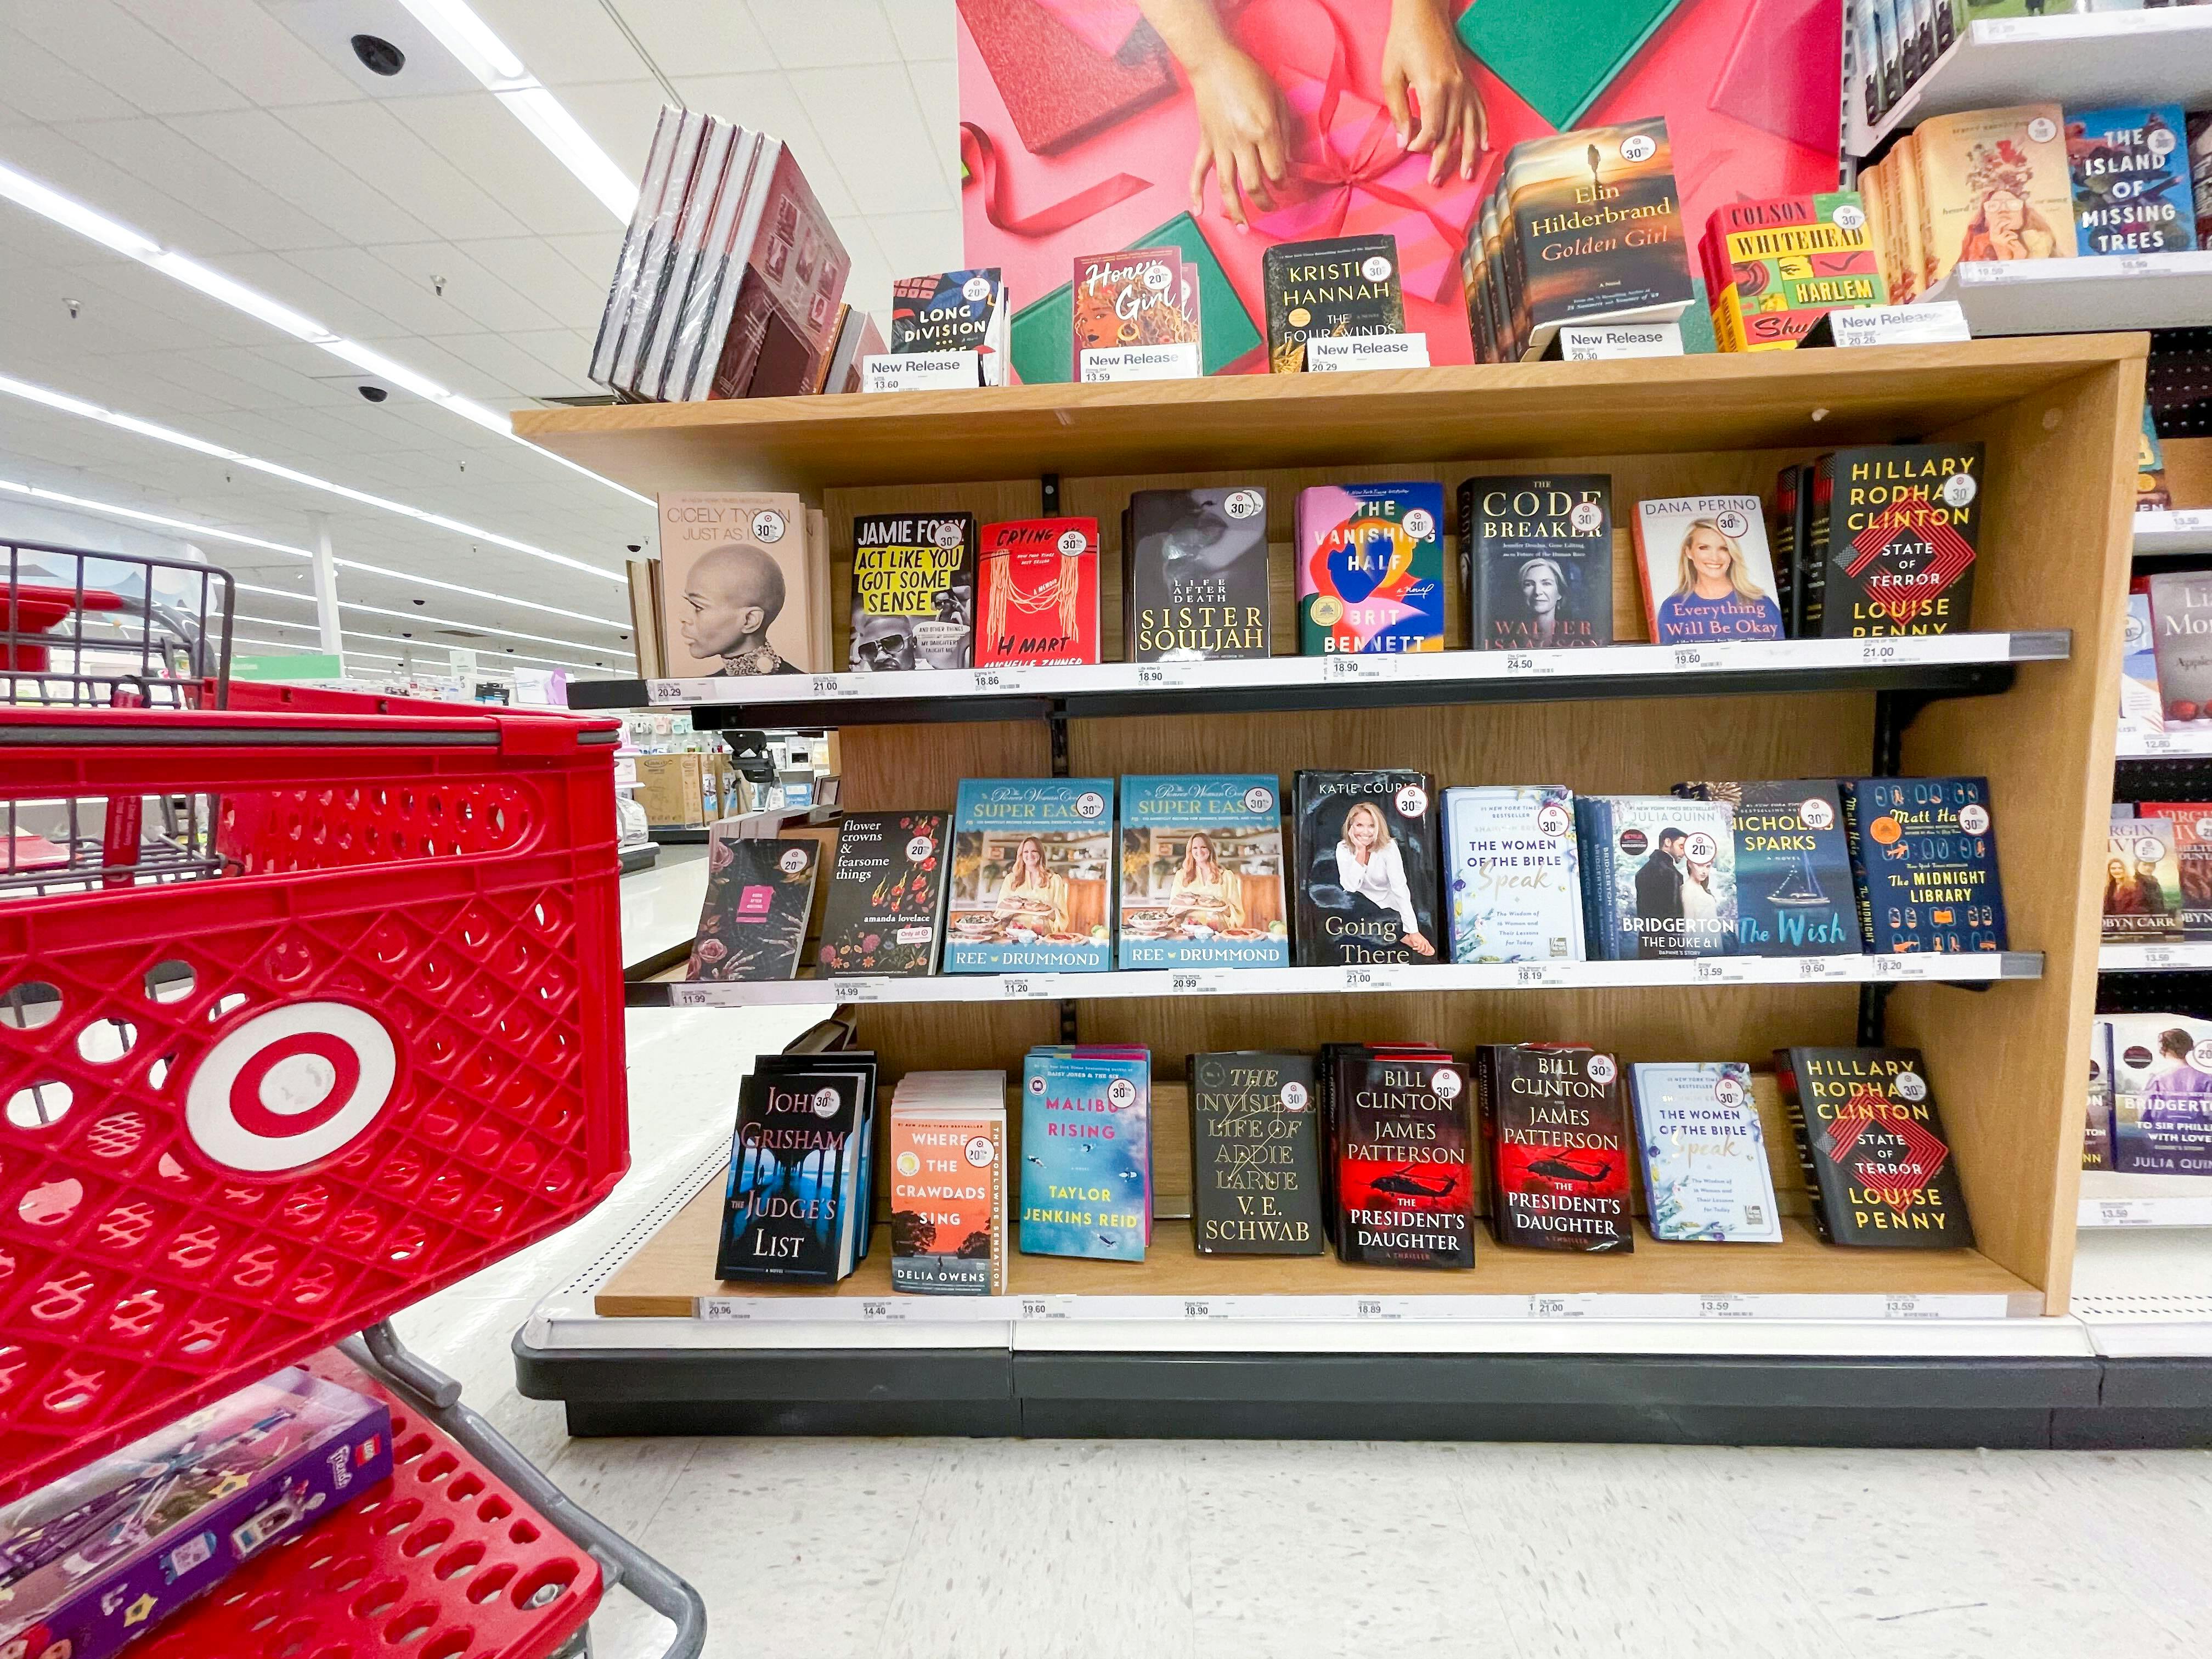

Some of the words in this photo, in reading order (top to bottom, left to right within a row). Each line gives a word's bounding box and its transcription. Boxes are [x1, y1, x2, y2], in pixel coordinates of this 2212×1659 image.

[2104, 128, 2144, 145] THE
[2085, 154, 2165, 176] ISLAND
[1576, 185, 1620, 204] Elin
[2112, 180, 2143, 199] OF
[1531, 197, 1671, 238] Hilderbrand
[1732, 201, 1807, 226] COLSON
[2082, 204, 2176, 228] MISSING
[1541, 236, 1617, 262] Golden
[1625, 225, 1668, 247] Girl
[1737, 228, 1864, 256] WHITEHEAD
[2098, 232, 2164, 252] TREES
[1283, 283, 1390, 306] HANNAH
[1796, 279, 1875, 303] HARLEM
[919, 304, 972, 324] LONG
[904, 320, 986, 343] DIVISION
[1571, 335, 1602, 345] New
[1607, 332, 1663, 343] Release
[871, 362, 902, 374] New
[906, 359, 961, 372] Release
[1312, 363, 1337, 371] 20.29
[1086, 373, 1110, 381] 13.59
[874, 380, 899, 388] 13.60
[1645, 501, 1692, 516] DANA
[1699, 498, 1757, 513] PERINO
[862, 571, 895, 591] GOT
[899, 571, 948, 590] SOME
[1039, 578, 1057, 592] MEMOIR
[1173, 586, 1226, 595] AFTER
[868, 591, 928, 613] SENSE
[1174, 595, 1226, 603] DEATH
[1673, 602, 1767, 620] Everything
[1141, 607, 1263, 630] SISTER
[1665, 622, 1706, 637] Will
[1709, 620, 1730, 634] Be
[1736, 619, 1779, 639] Okay
[1139, 628, 1263, 652] SOULJAH
[1864, 647, 1894, 657] 21.00
[1508, 660, 1532, 669] 24.50
[1675, 654, 1701, 665] 19.60
[1333, 663, 1358, 672] 18.90
[975, 676, 999, 686] 18.86
[1139, 672, 1163, 681] 18.90
[658, 688, 681, 697] 20.29
[814, 682, 838, 691] 21.00
[1630, 812, 1669, 822] JULIA
[1672, 812, 1715, 822] QUINN
[843, 820, 882, 832] flower
[842, 832, 883, 842] crowns
[1745, 835, 1816, 851] SPARKS
[1469, 841, 1496, 851] THE
[1502, 840, 1556, 850] WOMEN
[838, 856, 889, 867] fearsome
[1468, 857, 1486, 867] OF
[1491, 857, 1517, 867] THE
[1523, 856, 1561, 866] BIBLE
[836, 869, 872, 882] things
[1603, 847, 1612, 906] BRIDGERTON
[1888, 874, 1909, 887] The
[1913, 870, 1986, 886] MIDNIGHT
[1910, 888, 1972, 903] LIBRARY
[864, 914, 896, 922] amanda
[2137, 917, 2176, 928] CARR
[1325, 916, 1397, 942] Going
[1622, 917, 1734, 933] BRIDGERTON
[1642, 936, 1665, 947] THE
[1668, 937, 1701, 948] DUKE
[1703, 936, 1712, 948] &
[956, 952, 988, 965] REE
[1003, 952, 1099, 966] DRUMMOND
[1339, 944, 1410, 964] There
[1699, 967, 1722, 976] 13.59
[1800, 963, 1825, 973] 19.60
[1877, 962, 1901, 971] 18.20
[1173, 979, 1197, 988] 20.99
[1346, 974, 1370, 983] 21.00
[835, 988, 858, 997] 14.99
[1005, 984, 1028, 992] 11.20
[683, 995, 706, 1003] 11.99
[1384, 1070, 1426, 1087] BILL
[1356, 1092, 1453, 1111] CLINTON
[1816, 1104, 1928, 1120] CLINTON
[1048, 1122, 1115, 1139] RISING
[1374, 1122, 1436, 1141] JAMES
[2136, 1121, 2152, 1130] TO
[2155, 1122, 2174, 1130] SIR
[911, 1133, 968, 1146] WHERE
[1858, 1133, 1906, 1146] STATE
[2148, 1132, 2179, 1142] WITH
[2182, 1133, 2212, 1143] LOVE
[1347, 1143, 1465, 1164] PATTERSON
[1877, 1149, 1893, 1158] OF
[926, 1160, 957, 1172] THE
[1855, 1163, 1922, 1175] TERROR
[2133, 1156, 2174, 1169] JULIA
[896, 1185, 986, 1200] CRAWDADS
[1049, 1185, 1111, 1202] TAYLOR
[1848, 1187, 1943, 1206] LOUISE
[1237, 1196, 1254, 1216] V.
[1262, 1197, 1283, 1217] E.
[1397, 1199, 1416, 1207] THE
[919, 1212, 961, 1226] SING
[1024, 1209, 1092, 1225] JENKINS
[1099, 1212, 1137, 1229] REID
[1351, 1209, 1465, 1229] PRESIDENT'S
[1855, 1211, 1946, 1230] PENNY
[1206, 1220, 1310, 1242] SCHWAB
[1358, 1231, 1460, 1251] DAUGHTER
[897, 1268, 933, 1281] DELIA
[939, 1270, 985, 1282] OWENS
[709, 1307, 731, 1315] 20.96
[863, 1307, 886, 1316] 14.40
[1023, 1305, 1045, 1314] 19.60
[1186, 1307, 1208, 1316] 18.90
[1358, 1305, 1381, 1313] 18.89
[1539, 1304, 1563, 1312] 21.00
[1700, 1302, 1729, 1310] 13.59
[1886, 1302, 1914, 1310] 13.59
